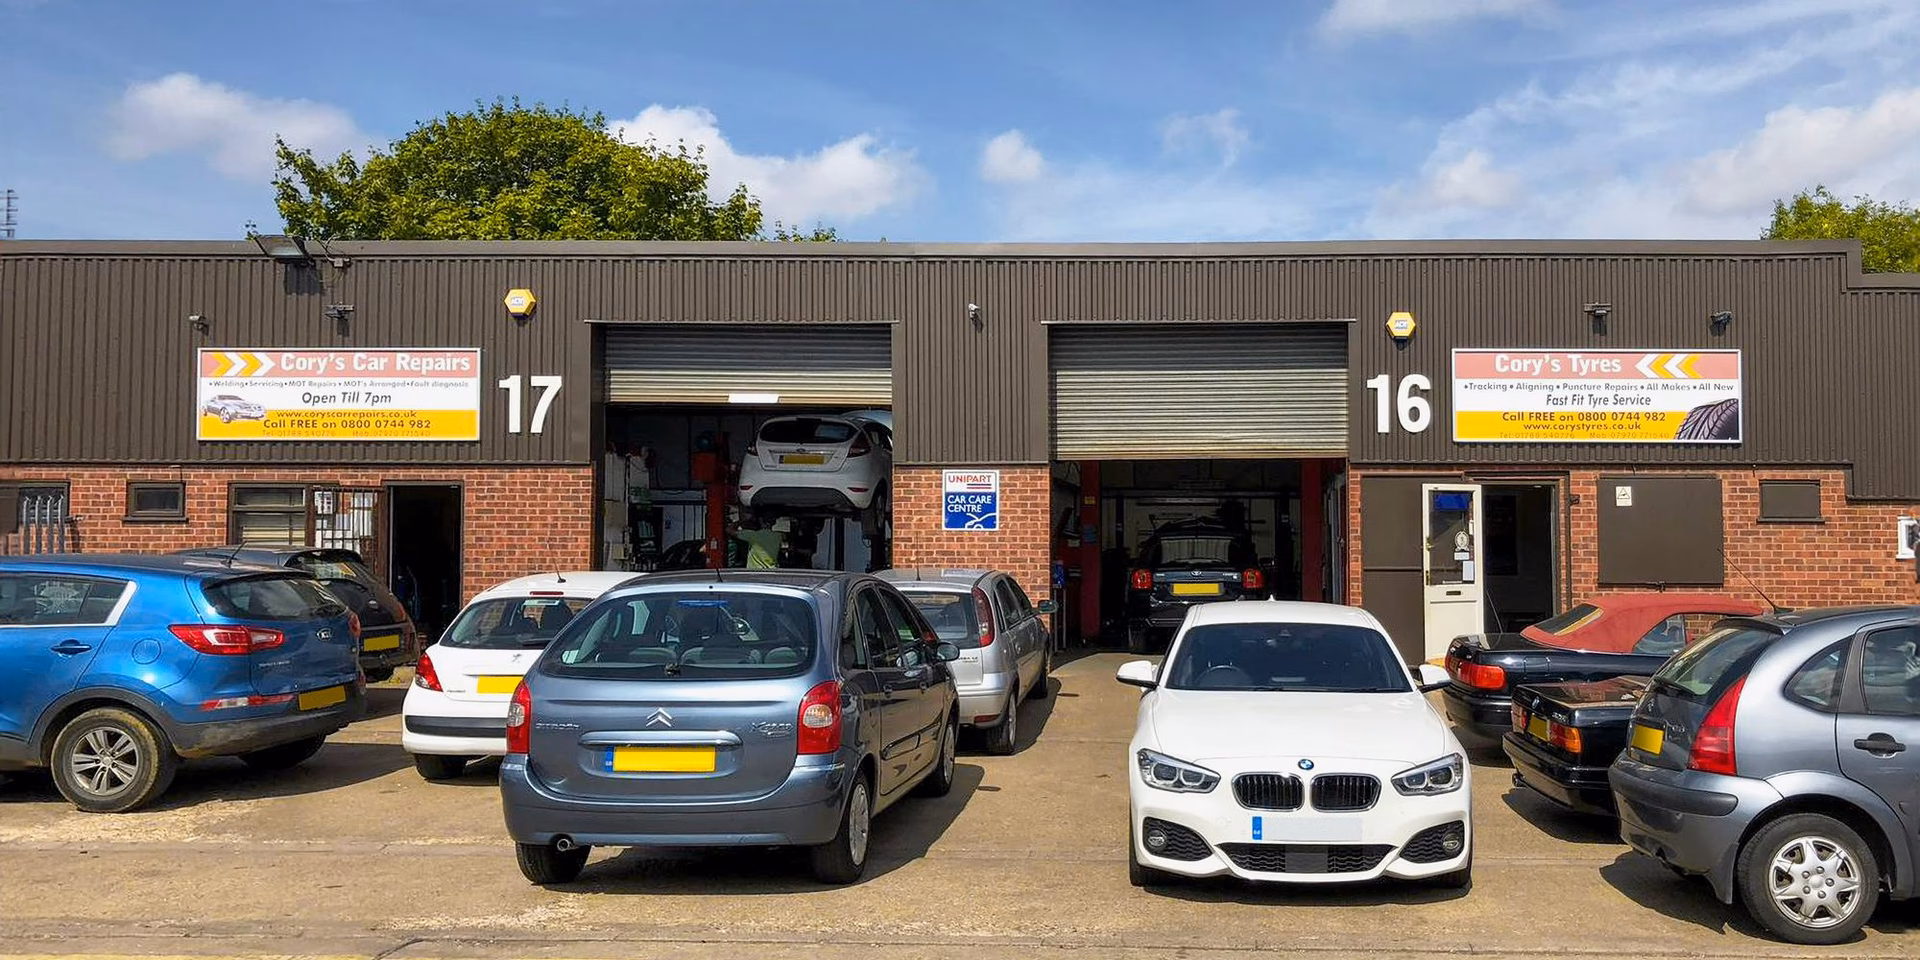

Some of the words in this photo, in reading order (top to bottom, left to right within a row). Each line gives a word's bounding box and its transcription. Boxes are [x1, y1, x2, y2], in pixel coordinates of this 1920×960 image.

[280, 352, 346, 375] Cory's
[353, 352, 389, 371] Car
[395, 351, 471, 376] Repairs
[1495, 353, 1562, 376] Cory's
[1567, 353, 1622, 376] Tyres
[213, 380, 245, 389] Welding
[249, 380, 284, 389] Servicing
[288, 380, 306, 388] MOT
[1468, 382, 1508, 392] Tracking
[1515, 382, 1555, 392] Aligning
[1562, 382, 1602, 391] Puncture
[1604, 382, 1638, 392] Repairs
[1646, 382, 1659, 391] All
[1661, 382, 1691, 391] Makes
[1698, 382, 1711, 391] All
[1713, 382, 1734, 391] New
[301, 392, 337, 406] Open
[341, 391, 360, 404] Till
[364, 391, 392, 406] 7pm
[498, 374, 563, 434] 17
[1366, 373, 1431, 433] 16
[1546, 393, 1568, 406] Fast
[1571, 393, 1585, 406] Fit
[1587, 393, 1609, 409] Tyre
[1612, 393, 1652, 406] Service
[276, 409, 418, 419] www.coryscarrepairs.co.uk
[1502, 411, 1525, 422] Call
[1528, 411, 1555, 422] FREE
[1559, 413, 1574, 422] on
[1577, 411, 1607, 422] 0800
[1611, 411, 1641, 422] 0744
[1644, 411, 1666, 422] 982
[263, 419, 286, 429] Call
[290, 419, 319, 429] FREE
[322, 421, 337, 429] on
[341, 419, 371, 429] 0800
[375, 419, 405, 429] 0744
[409, 419, 431, 429] 982
[1523, 421, 1641, 432] www.corystyres.co.uk
[947, 474, 993, 484] UNIPART
[947, 494, 967, 504] CAR
[968, 494, 993, 504] CARE
[947, 504, 983, 513] CENTRE
